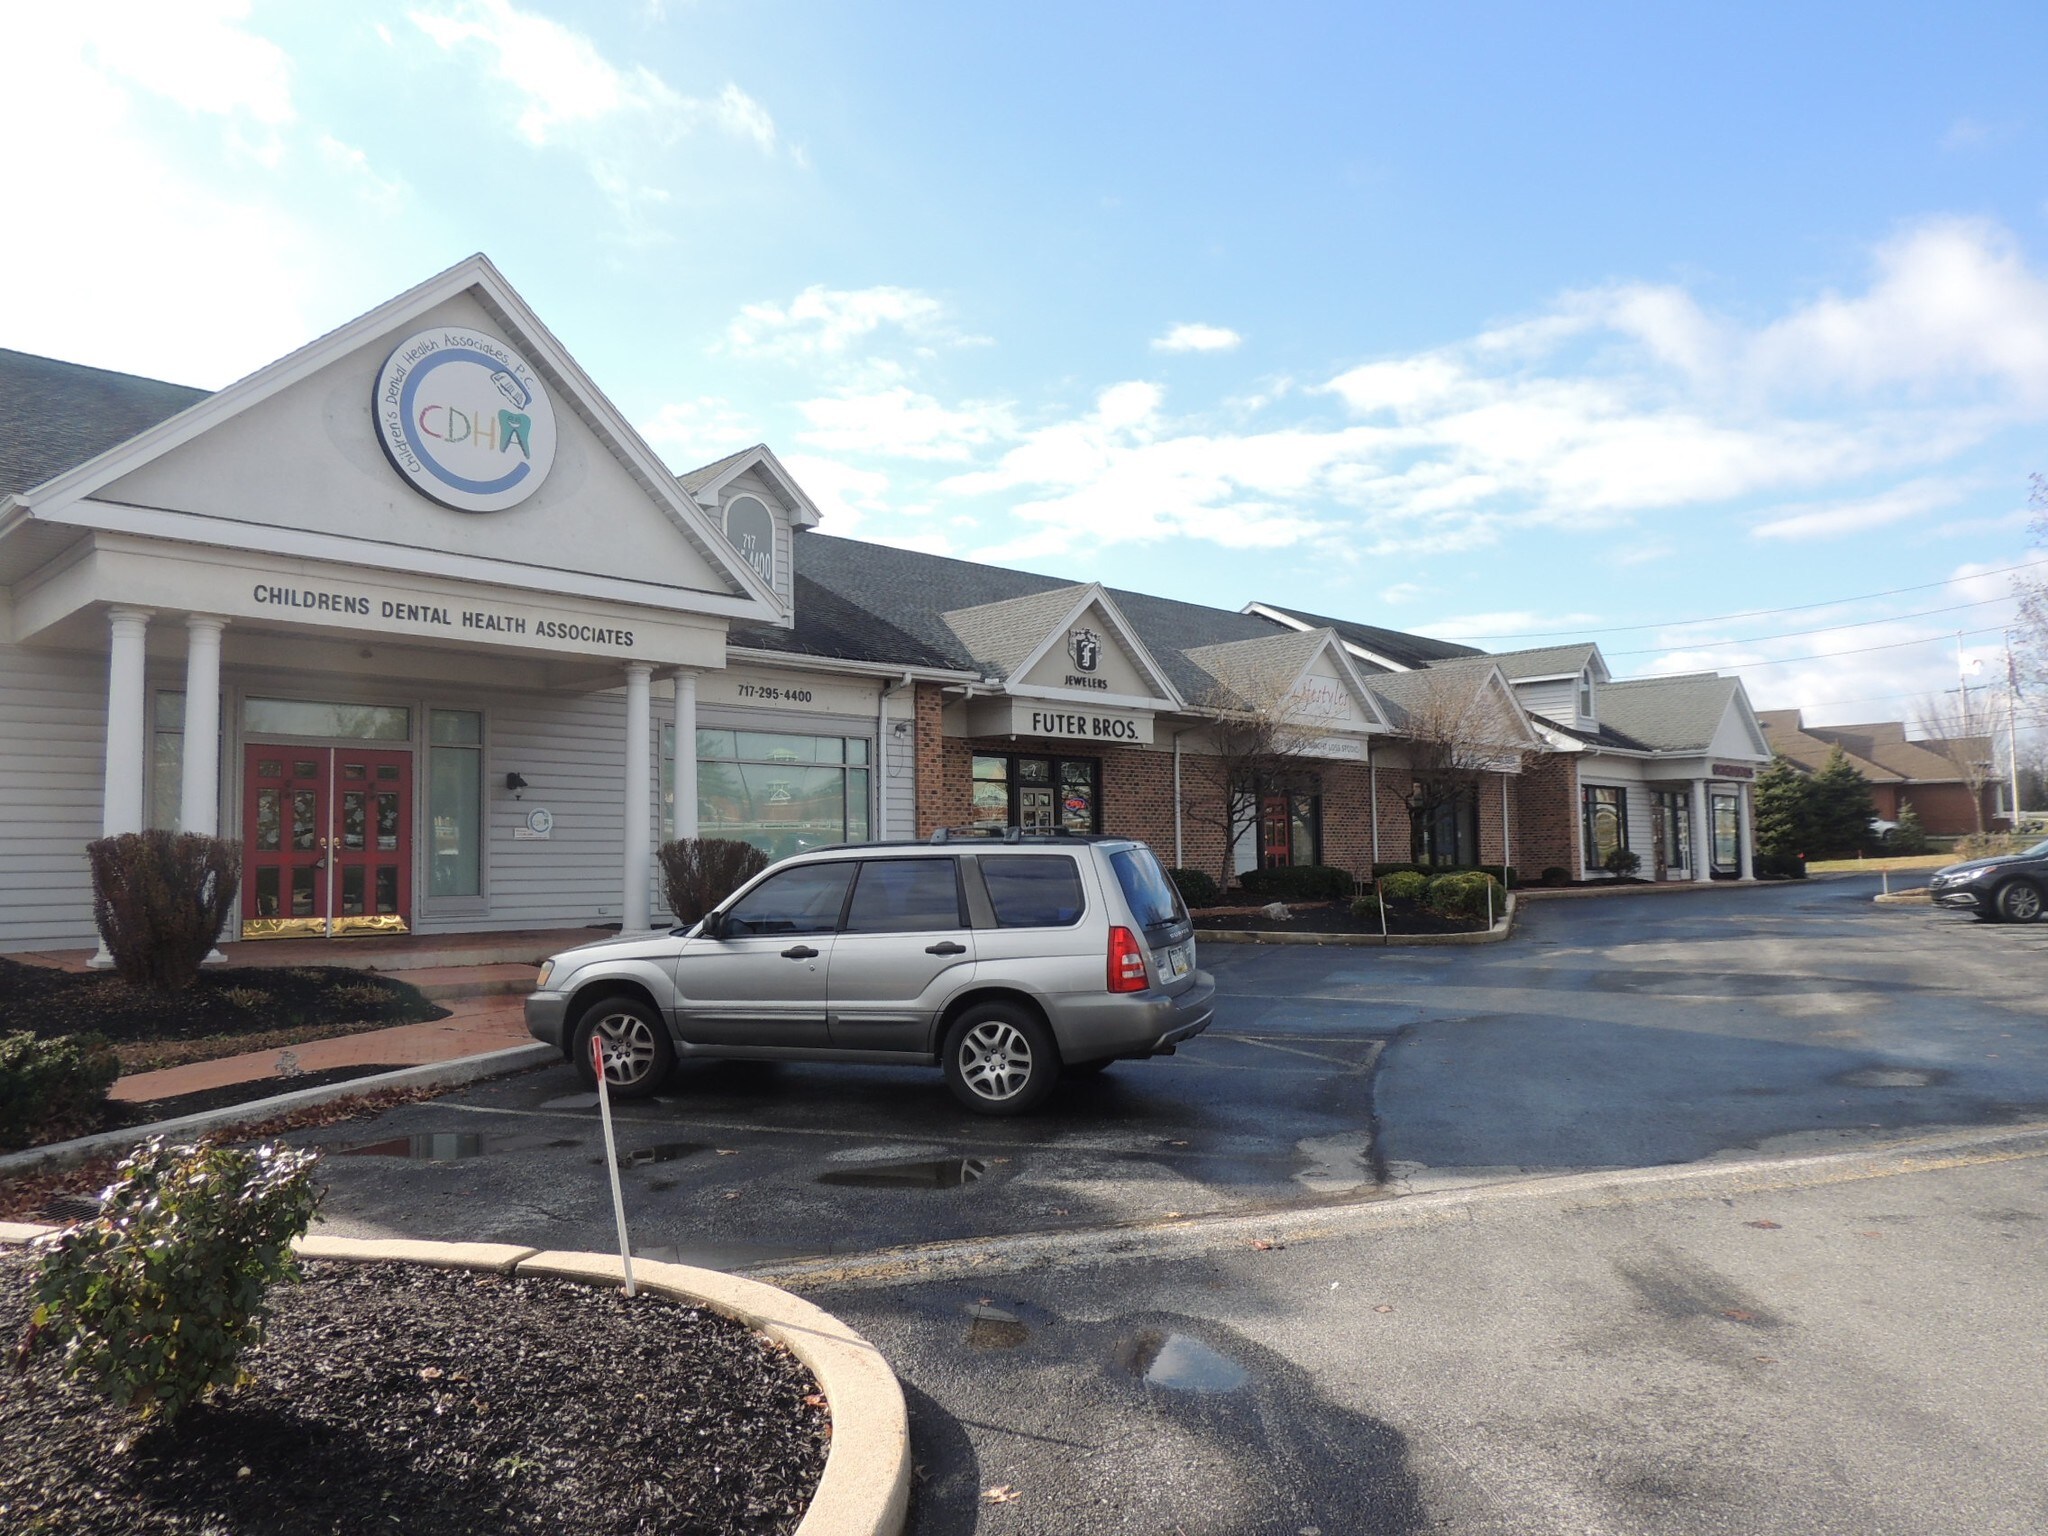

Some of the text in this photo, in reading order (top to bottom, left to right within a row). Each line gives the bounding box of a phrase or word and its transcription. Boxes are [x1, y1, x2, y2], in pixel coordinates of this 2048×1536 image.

[402, 339, 440, 365] Health
[386, 364, 407, 406] Dental
[386, 411, 421, 473] Children's
[743, 533, 756, 550] 717
[253, 584, 634, 647] CHILDRENS DENTAL HEALTH ASSOCIATES
[738, 684, 812, 702] 717-295-4400
[1064, 675, 1108, 690] JEWELERS
[1032, 713, 1139, 740] FUTER BROS.
